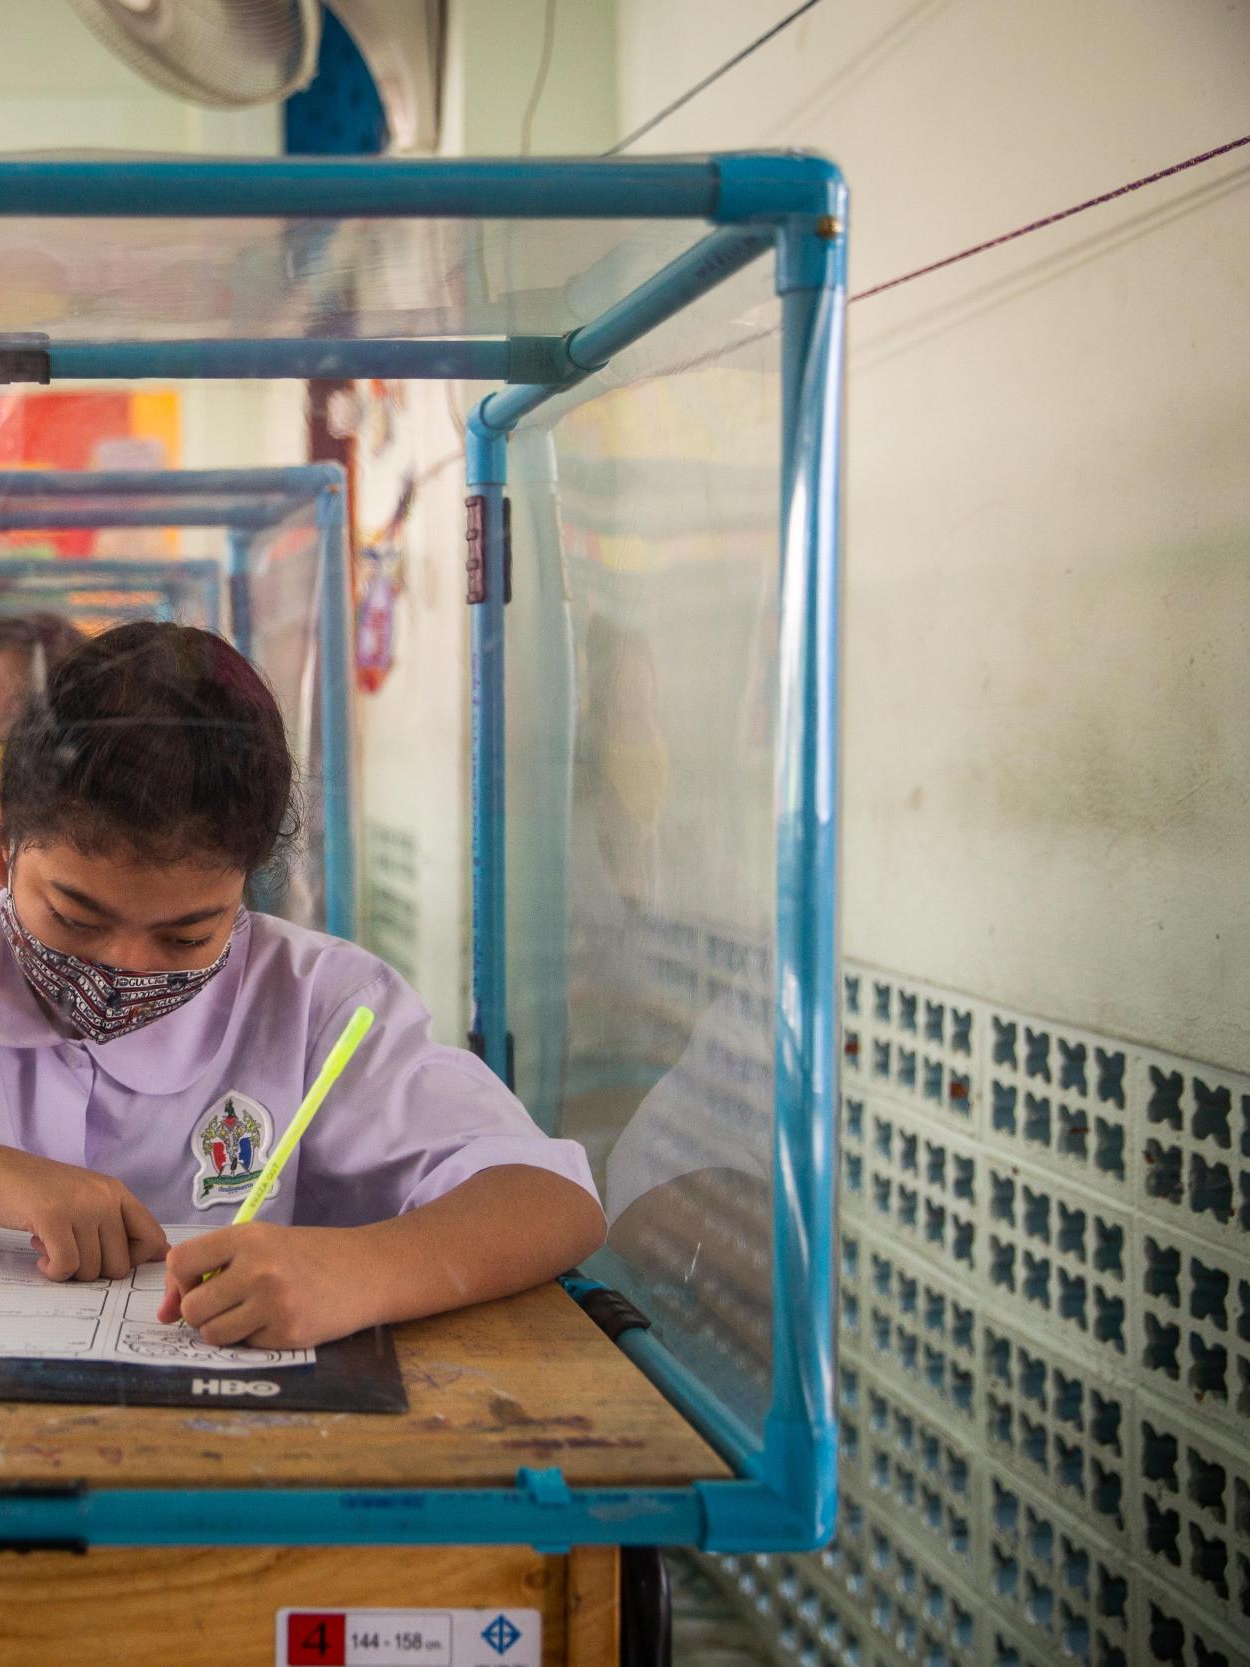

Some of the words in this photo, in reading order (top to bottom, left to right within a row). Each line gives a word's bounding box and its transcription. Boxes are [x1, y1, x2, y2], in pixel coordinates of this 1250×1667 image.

[129, 977, 157, 987] GUCCI
[192, 1378, 280, 1397] HBO
[302, 1622, 332, 1657] 4
[352, 1633, 379, 1650] 144
[395, 1633, 422, 1650] 158
